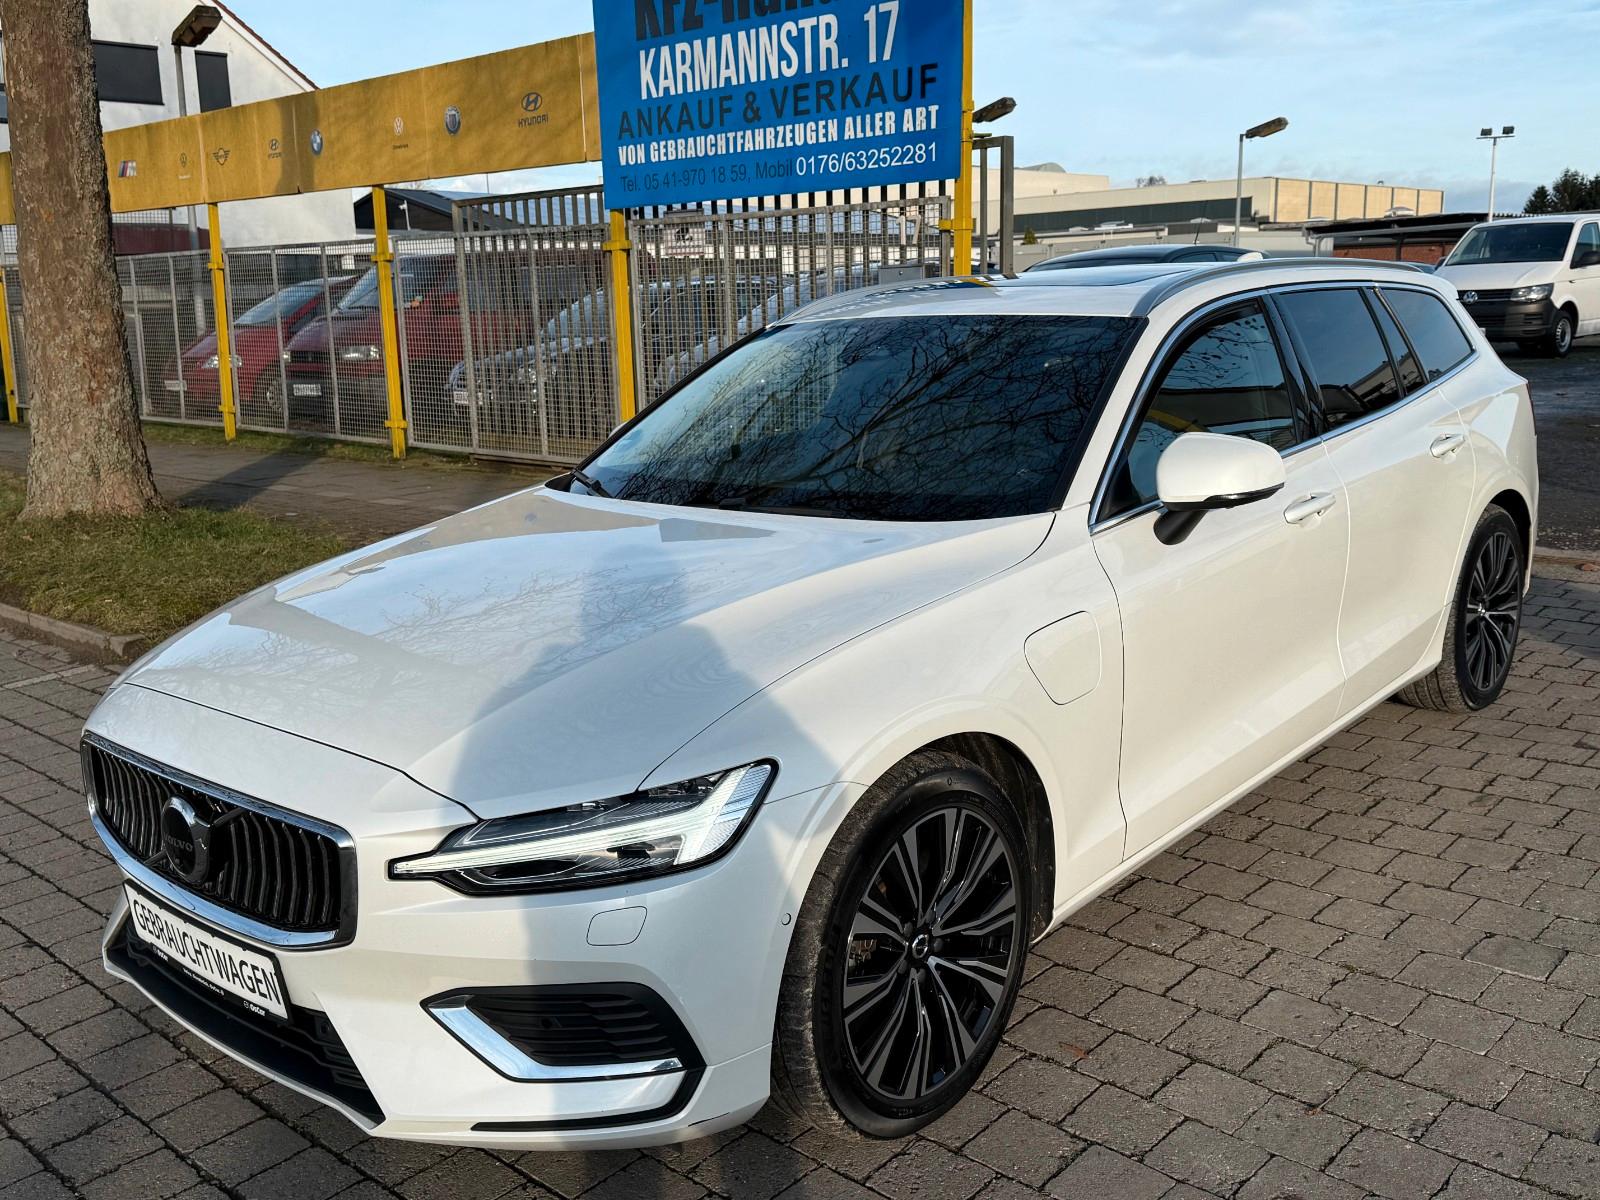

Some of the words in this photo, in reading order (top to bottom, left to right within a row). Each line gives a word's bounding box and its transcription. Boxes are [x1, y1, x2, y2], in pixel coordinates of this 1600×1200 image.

[639, 13, 849, 100] KARMANNSTR.
[863, 0, 900, 63] 17
[617, 94, 734, 141] ANKAUF
[742, 92, 762, 124] &
[769, 63, 939, 119] VERKAUF
[618, 143, 646, 166] VON
[650, 118, 838, 163] GEBRAUCHTFAHRZEUGEN
[843, 110, 896, 140] ALLER
[902, 104, 940, 133] ART
[620, 175, 641, 192] Tel.
[644, 173, 660, 190] 05
[662, 168, 706, 189] 41-970
[711, 165, 727, 184] 18
[755, 160, 793, 179] Mobil
[795, 141, 937, 176] 0176/63252281
[895, 215, 922, 245] 17
[133, 899, 282, 1006] GEBRAUCHTWAGEN
